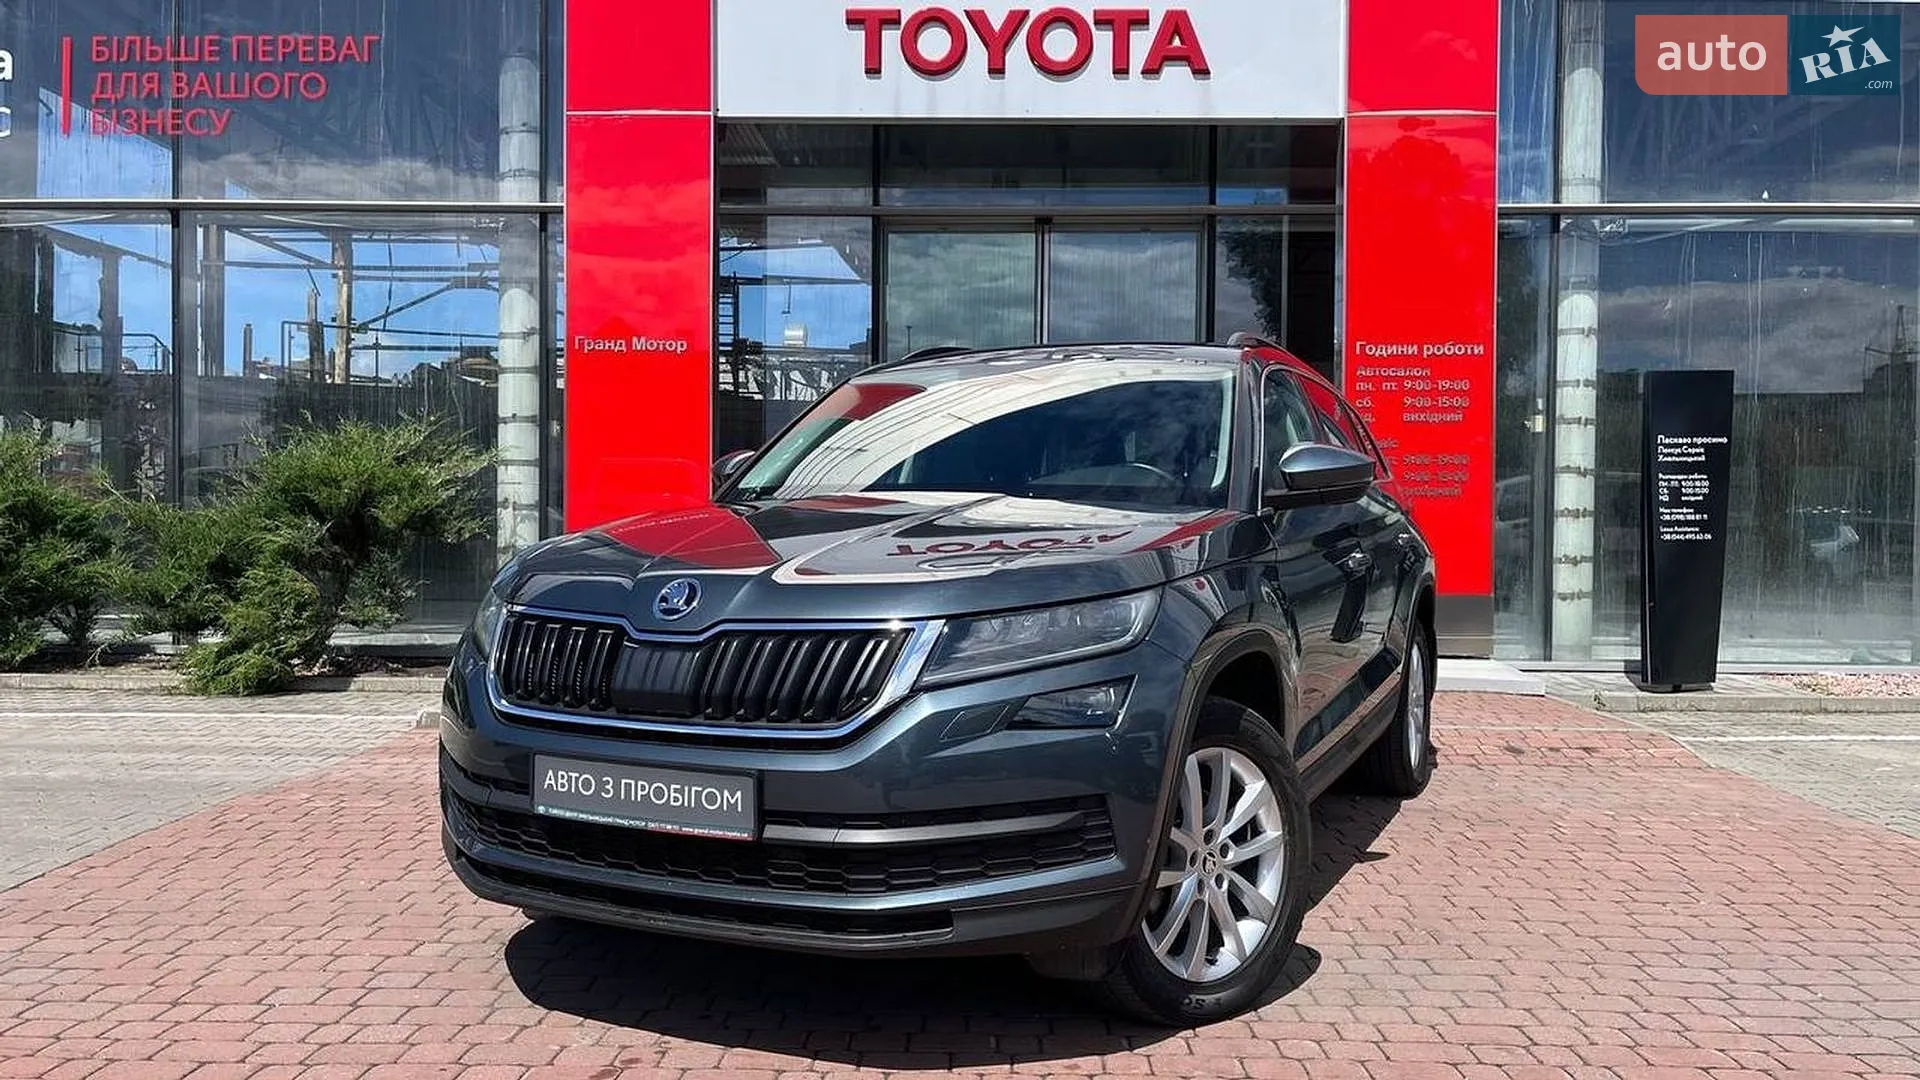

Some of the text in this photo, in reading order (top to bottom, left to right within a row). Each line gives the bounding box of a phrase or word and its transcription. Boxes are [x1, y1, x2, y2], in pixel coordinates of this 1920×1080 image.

[91, 35, 381, 64] БІЛЬШЕ ПЕРЕВАГ
[845, 8, 1211, 78] TOYOTA
[91, 71, 328, 103] ДЛЯ ВАШОГО
[91, 108, 233, 137] БІЗНЕСУ
[574, 335, 688, 354] Гранд Мотор
[1355, 341, 1485, 358] Години роботи
[1356, 366, 1431, 377] Автосалон
[543, 769, 596, 796] АВТО
[620, 779, 743, 813] ПРОБІГОМ
